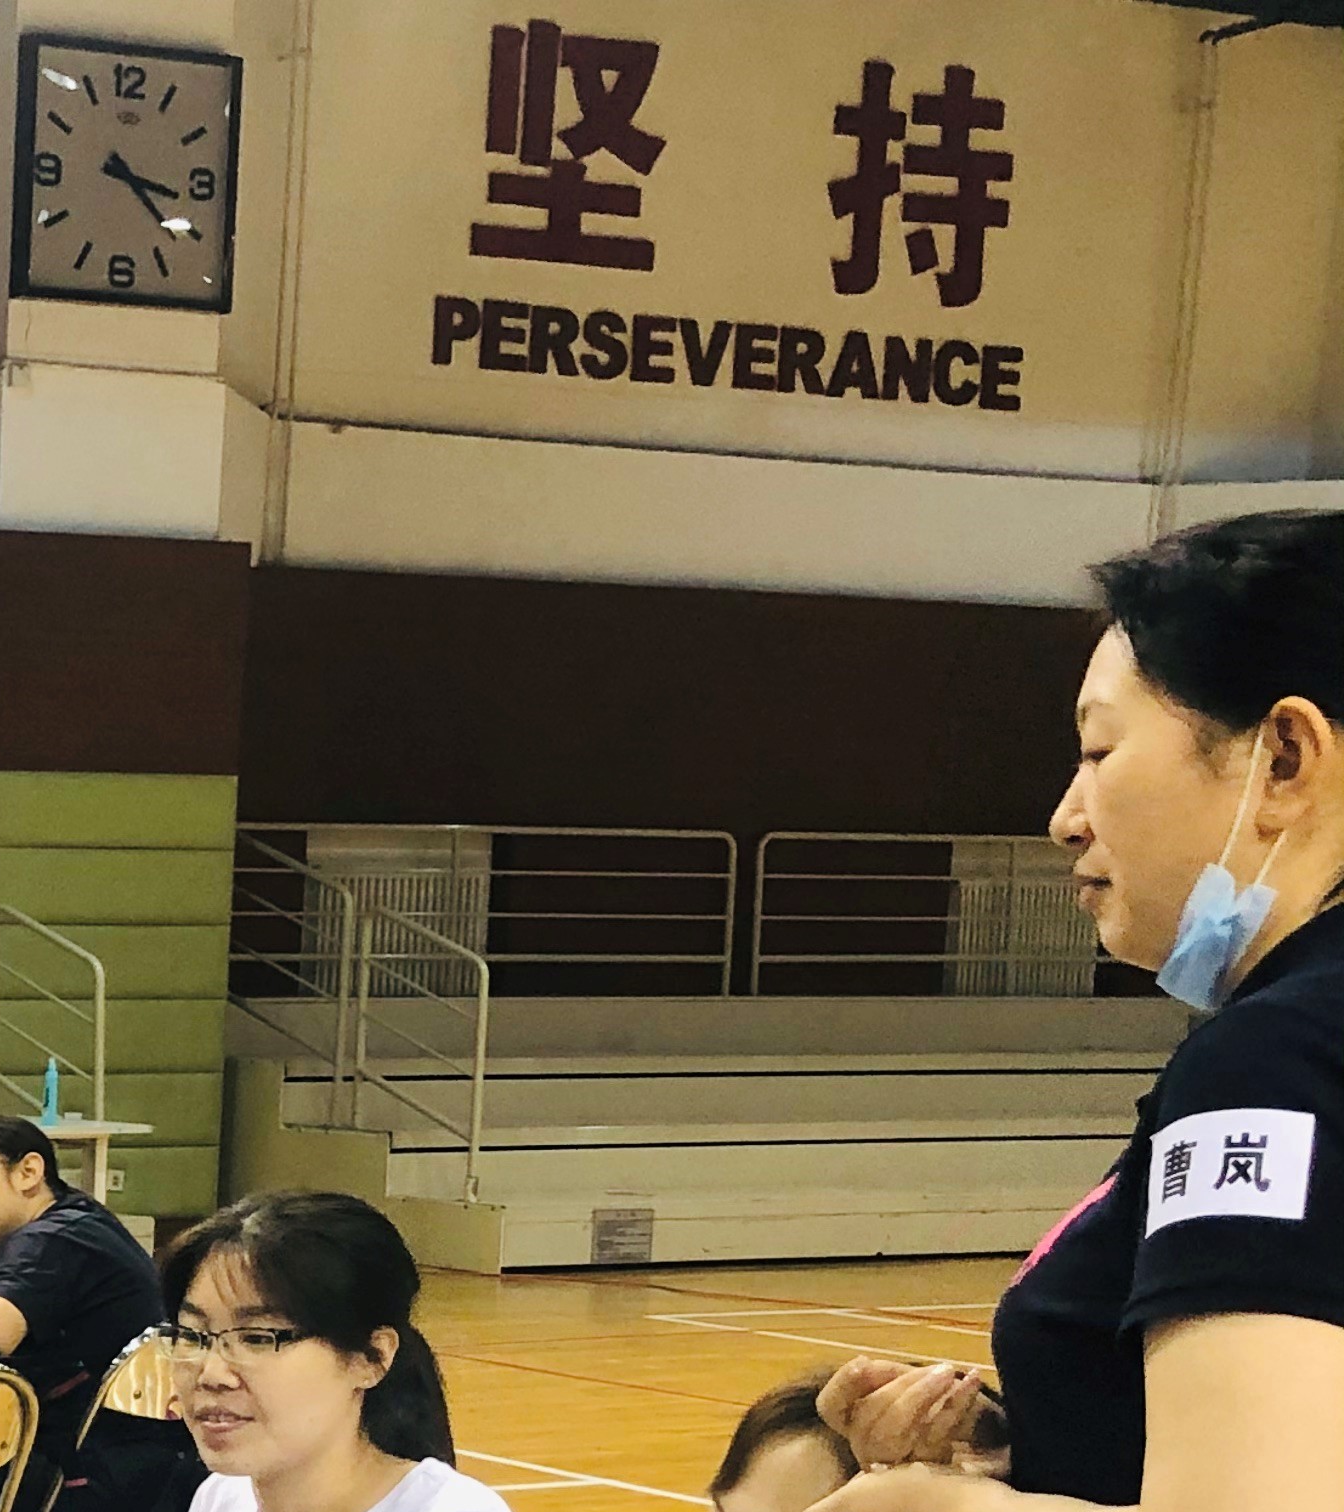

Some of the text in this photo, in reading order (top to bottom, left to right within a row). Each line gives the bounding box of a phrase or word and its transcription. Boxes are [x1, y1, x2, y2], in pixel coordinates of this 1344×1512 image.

[113, 63, 146, 100] 12
[33, 152, 62, 187] 9
[468, 18, 1014, 308] 坚持
[189, 167, 216, 201] 3
[107, 254, 136, 288] 6
[430, 294, 1025, 411] PERSEVERANCE
[1162, 1131, 1272, 1204] 曹岚
